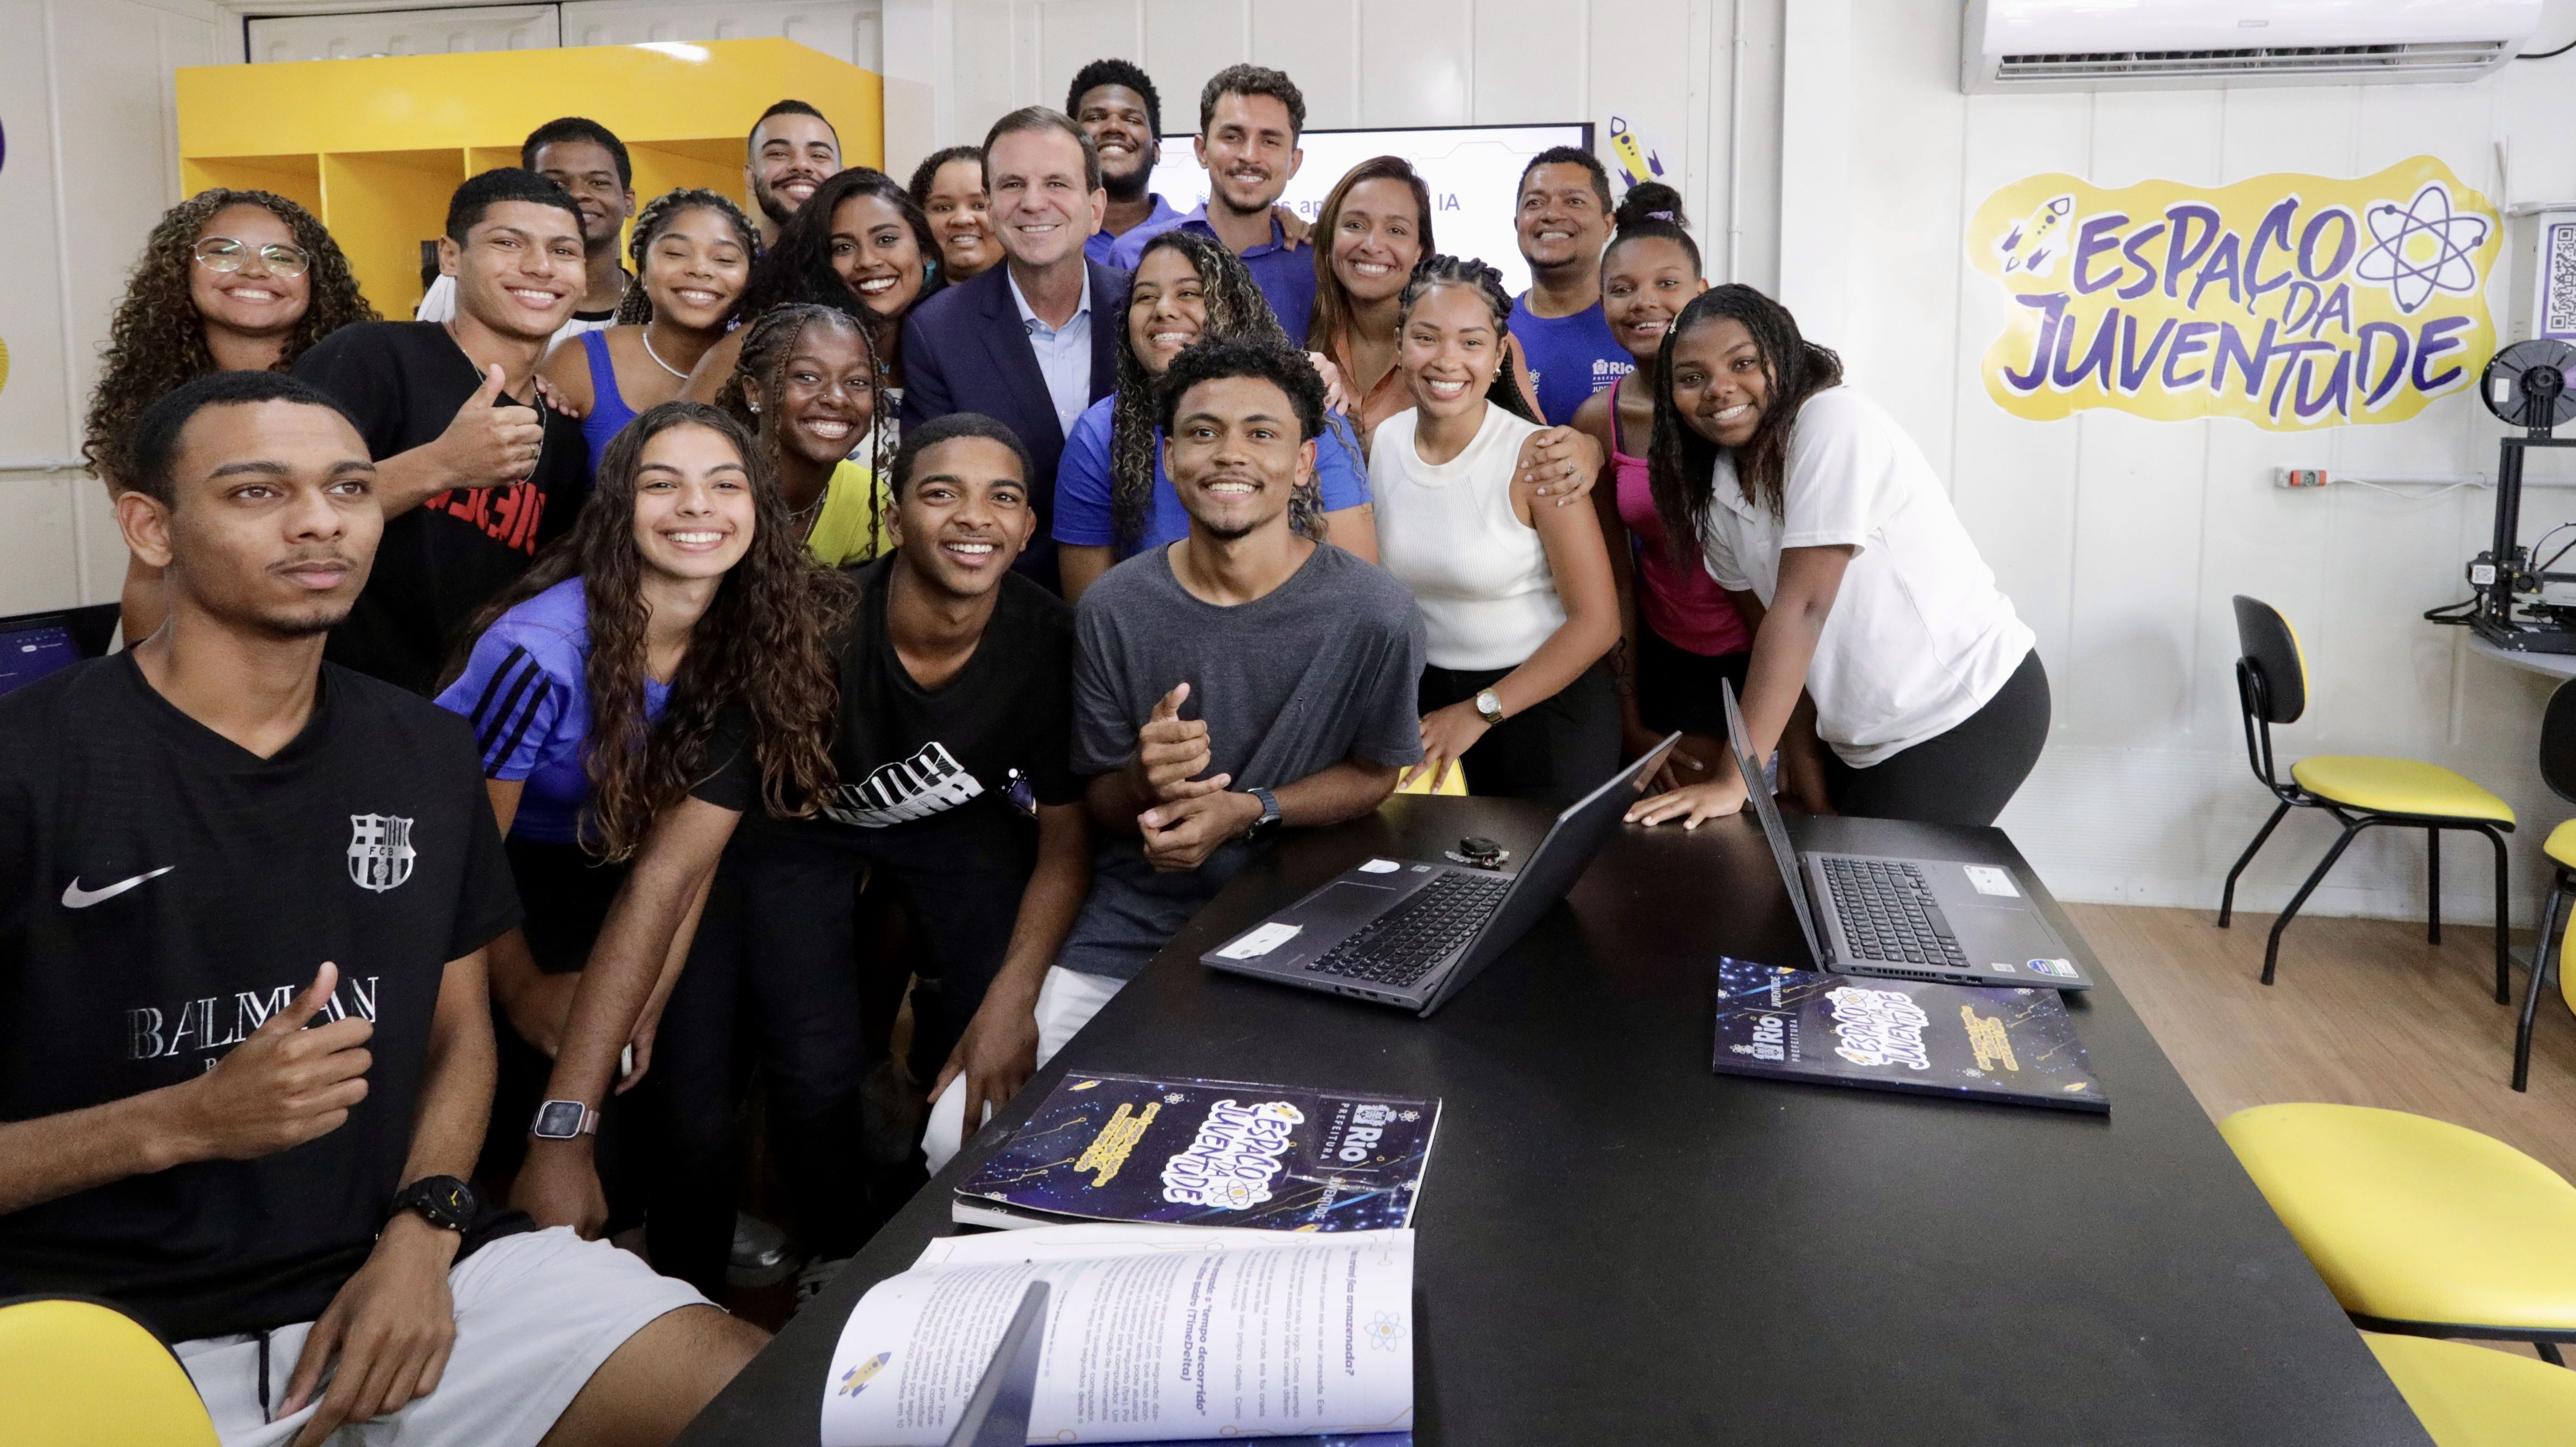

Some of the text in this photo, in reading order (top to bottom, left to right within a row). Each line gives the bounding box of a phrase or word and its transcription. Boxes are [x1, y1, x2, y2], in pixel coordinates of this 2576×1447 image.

[1439, 194, 1460, 211] IA
[2073, 198, 2357, 316] ESPAÇO
[2283, 281, 2351, 337] DA
[1609, 362, 1635, 375] Rio
[2004, 294, 2469, 418] JUVENTUDE
[1770, 975, 1782, 1008] JUVENTUDE
[1752, 1016, 1784, 1044] Rio
[1836, 1007, 1881, 1053] ESPAÇO
[1868, 1009, 1889, 1020] DA
[1877, 993, 1925, 1067] JUVENTUDE
[1789, 1018, 1800, 1063] PREFEITURA
[1319, 1102, 1350, 1160] PREFEITURA
[1338, 1125, 1383, 1162] Rio
[1170, 1103, 1260, 1200] JUVENTUDE
[1233, 1118, 1287, 1179] ESPAÇO
[1208, 1162, 1237, 1178] DA
[1313, 1175, 1343, 1220] JUVENTUDE
[1091, 1335, 1101, 1370] qualquer
[1135, 1342, 1144, 1362] lento
[1180, 1309, 1198, 1382] (TimeDelta)
[1236, 1332, 1244, 1361] próprio
[1346, 1295, 1355, 1376] armazenada?
[912, 1344, 925, 1381] unidades
[921, 1351, 933, 1382] permite
[936, 1348, 943, 1361] em
[941, 1337, 956, 1385] multiplicado
[967, 1359, 975, 1379] valor
[979, 1343, 989, 1365] todos
[1079, 1347, 1089, 1388] segundos
[1104, 1358, 1111, 1369] de
[1123, 1348, 1133, 1384] segundo
[899, 1361, 911, 1400] unidades
[931, 1362, 941, 1386] todos
[954, 1366, 963, 1399] passou.
[965, 1381, 972, 1392] da
[1196, 1346, 1208, 1416] decorrido”
[1234, 1364, 1243, 1393] objeto.
[897, 1402, 903, 1416] em
[906, 1399, 915, 1429] segun-
[917, 1384, 927, 1427] quantificar
[928, 1388, 936, 1427] computa-
[1102, 1371, 1111, 1423] movimentos.
[1259, 1392, 1267, 1419] criada.
[897, 1419, 904, 1428] 10
[1112, 1408, 1120, 1423] Um
[1122, 1408, 1130, 1423] Por
